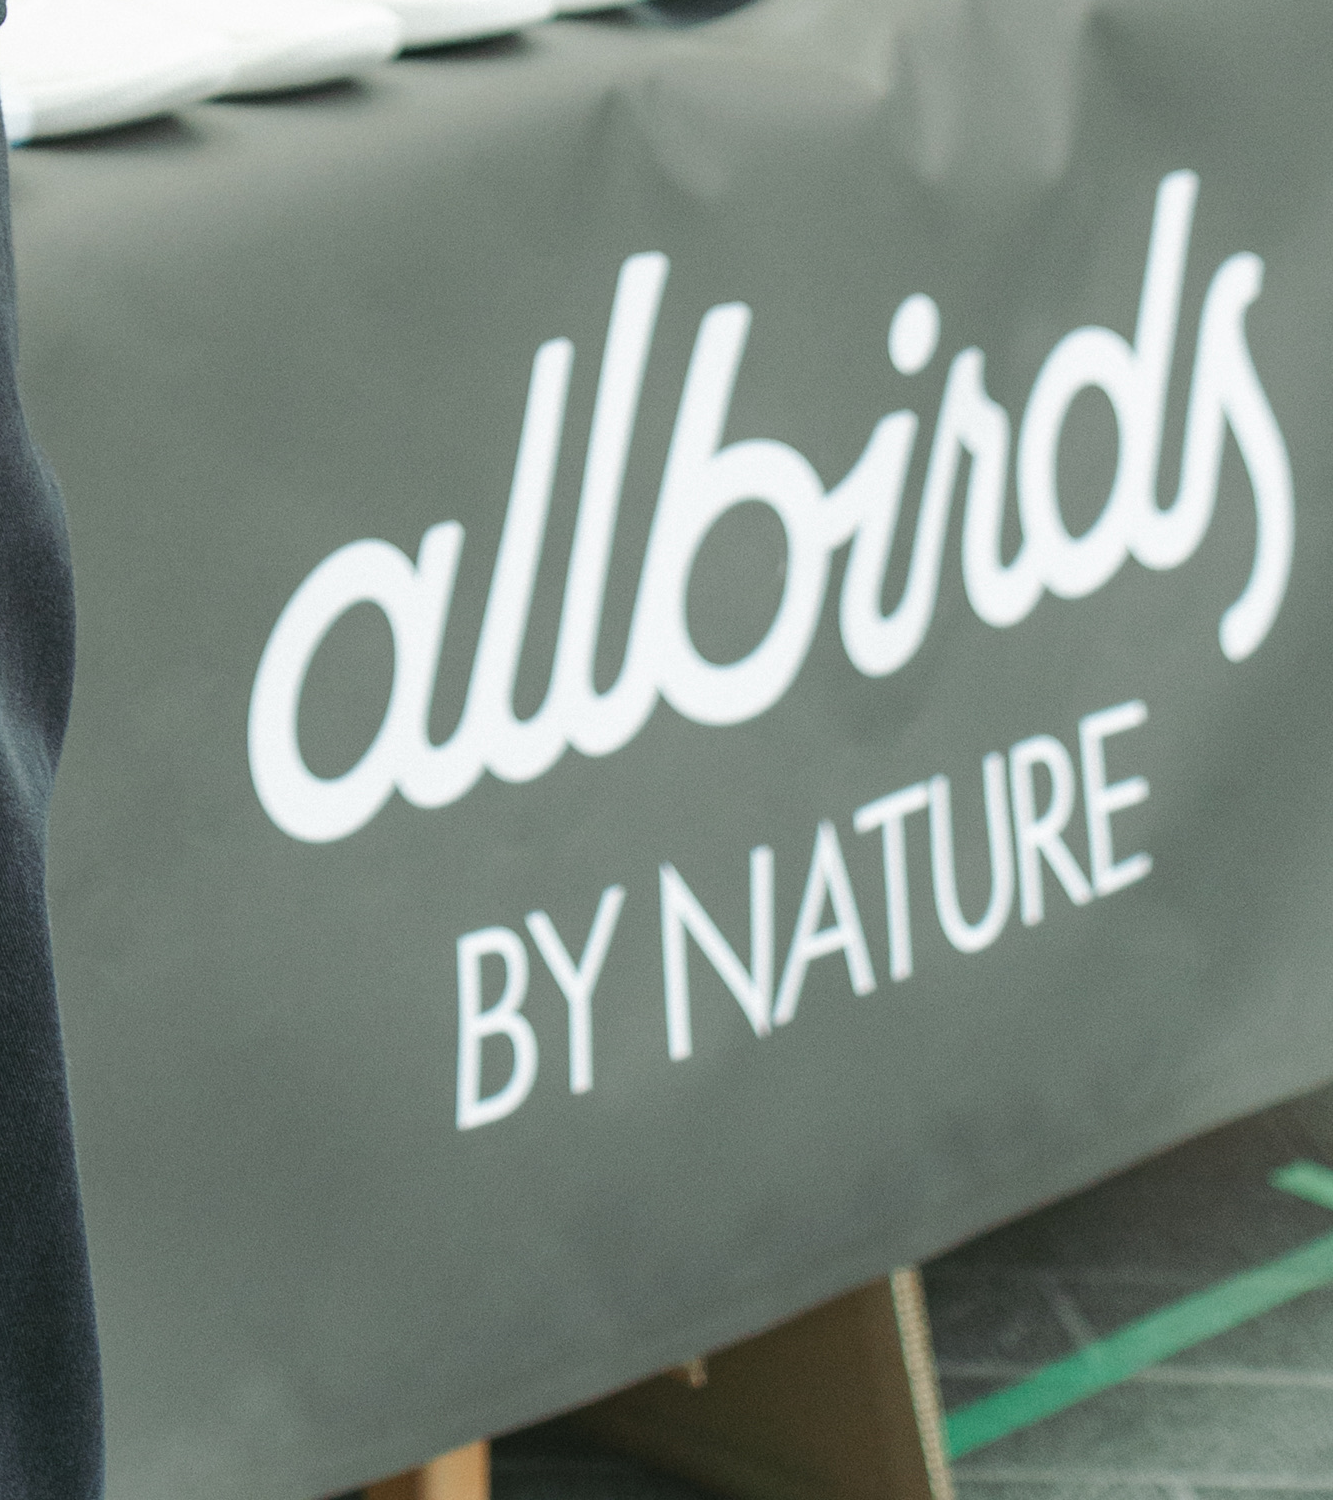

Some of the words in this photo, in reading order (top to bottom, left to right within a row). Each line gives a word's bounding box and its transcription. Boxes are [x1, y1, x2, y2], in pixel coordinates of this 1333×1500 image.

[246, 168, 1296, 844] allbirds
[456, 885, 626, 1132] BY
[659, 699, 1153, 1062] NATURE
